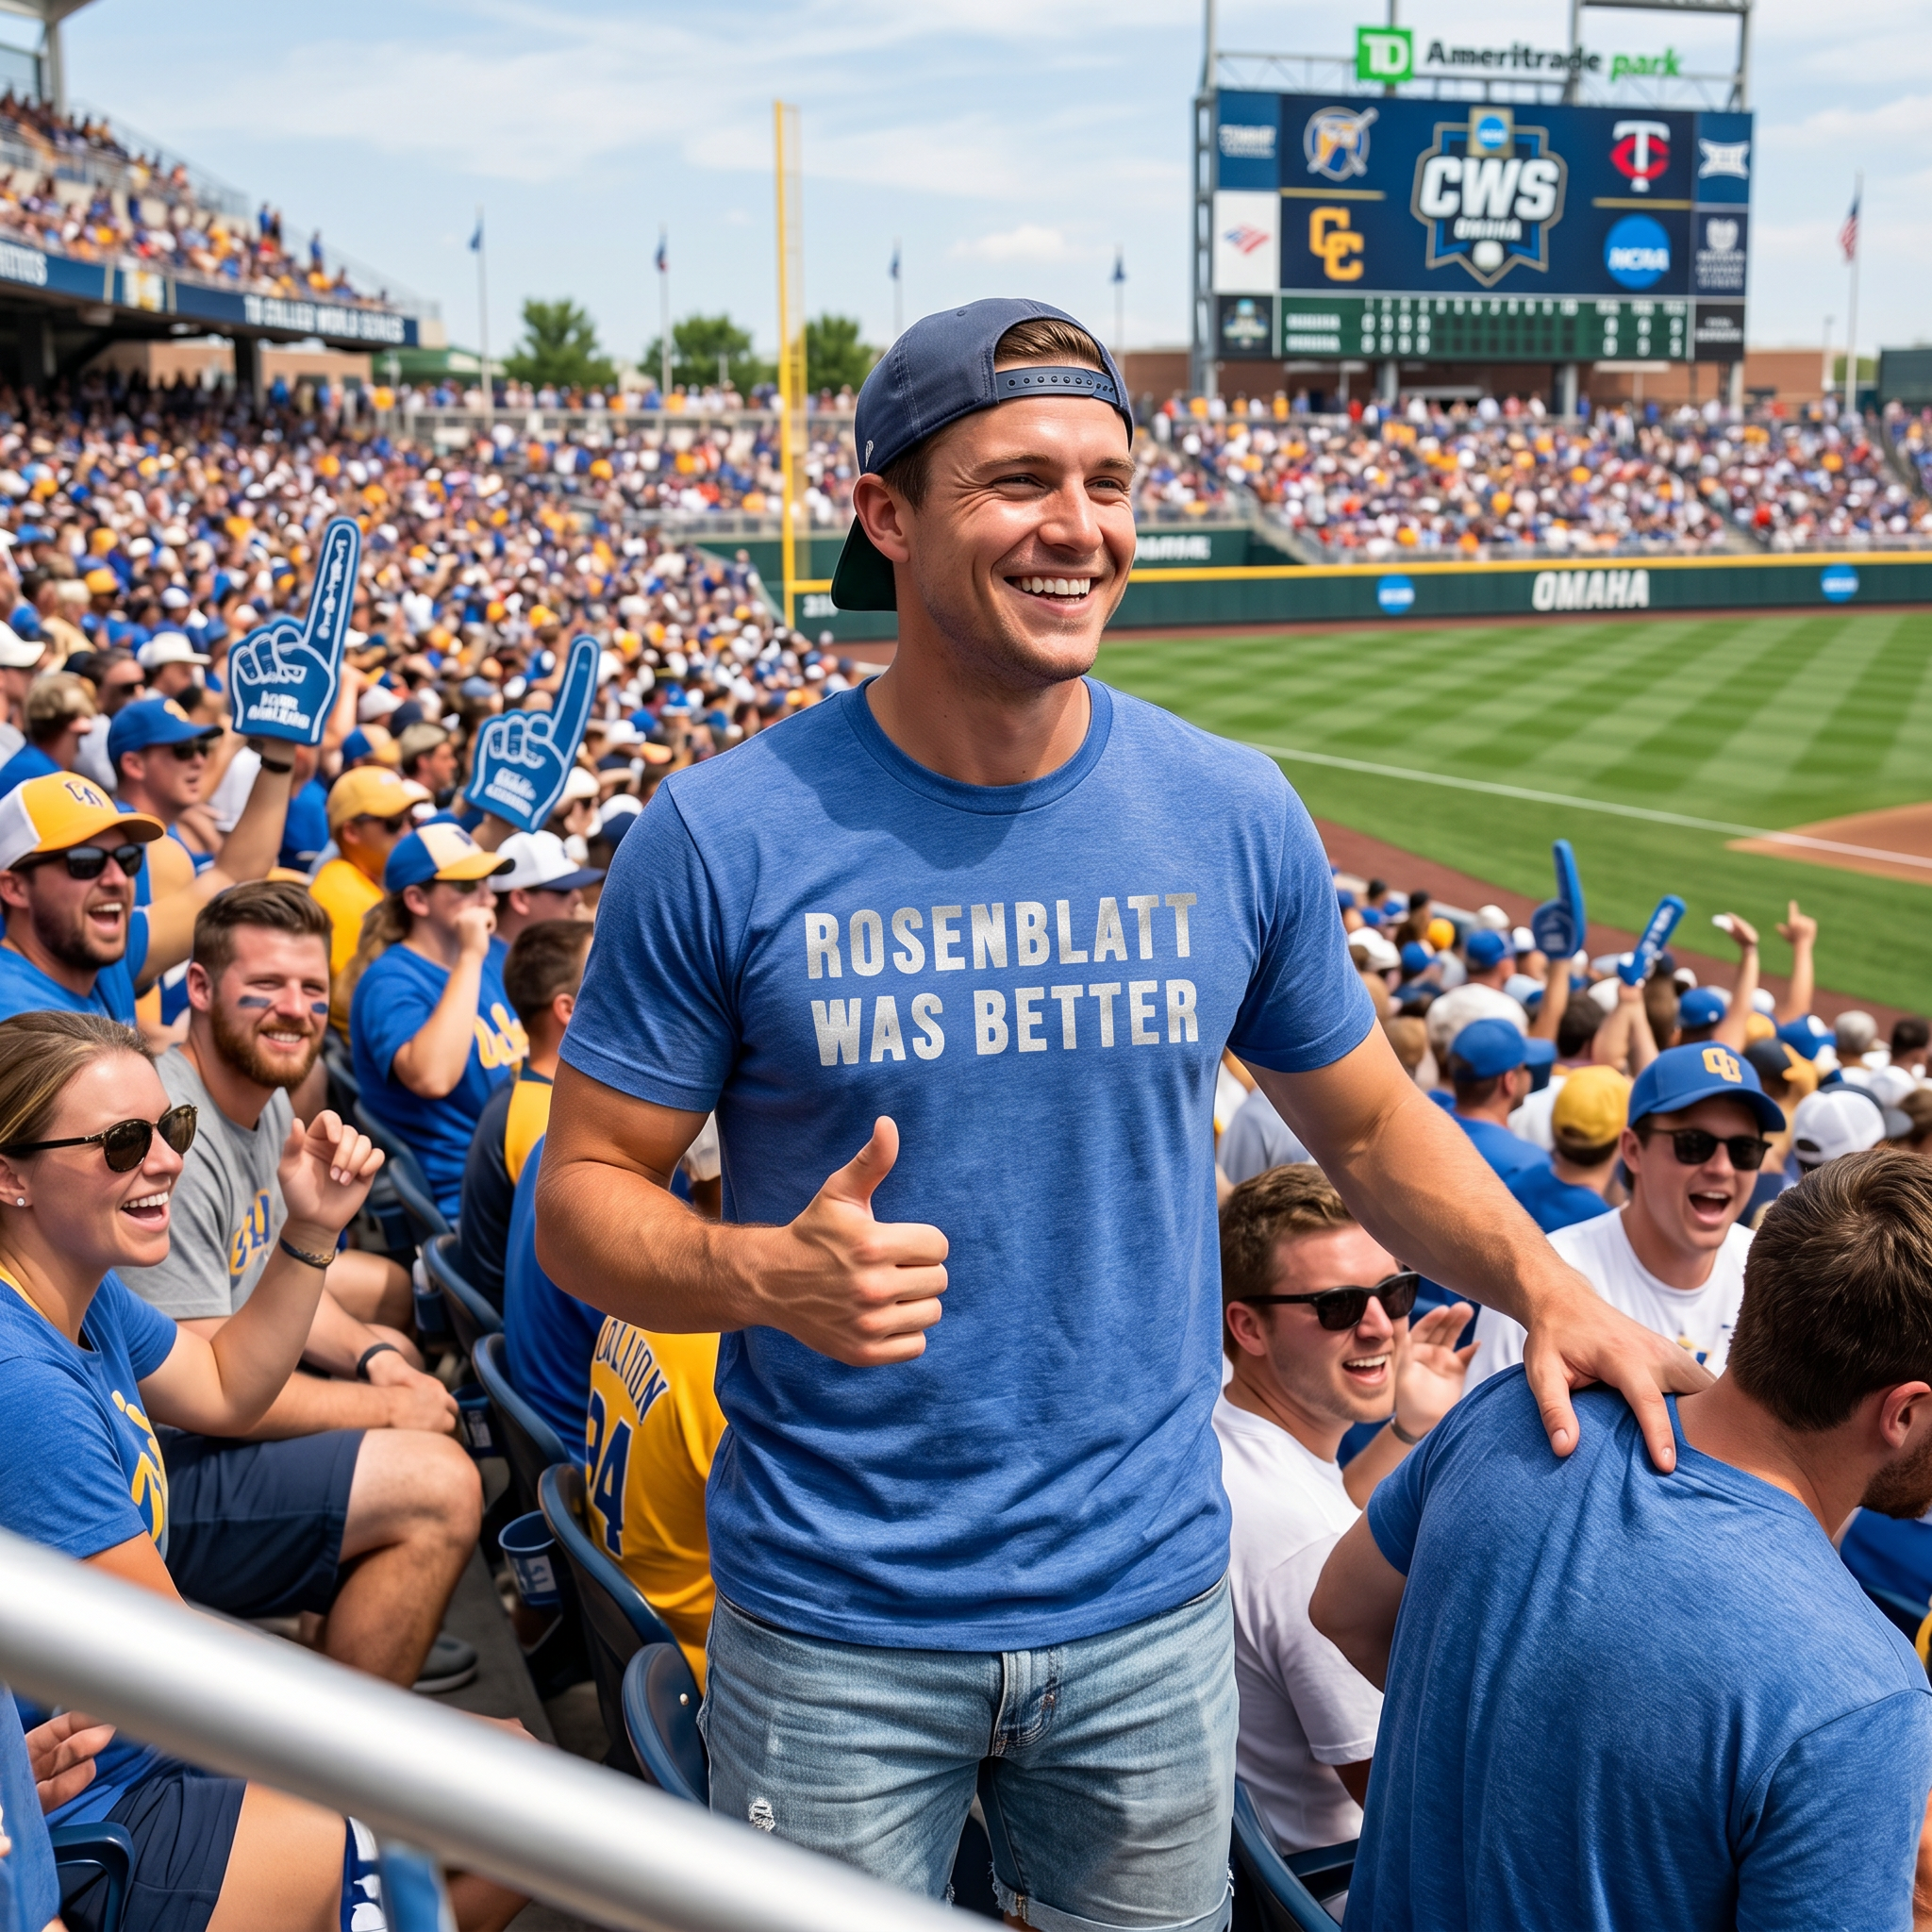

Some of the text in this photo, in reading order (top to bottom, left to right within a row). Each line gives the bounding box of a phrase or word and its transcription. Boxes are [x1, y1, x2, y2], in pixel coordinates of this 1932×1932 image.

[1360, 33, 1682, 83] TD Ameritrade park
[1419, 156, 1559, 221] CWS
[1532, 569, 1650, 611] OMAHA
[805, 892, 1197, 979] ROSENBLATT
[810, 978, 1199, 1066] WAS BETTER
